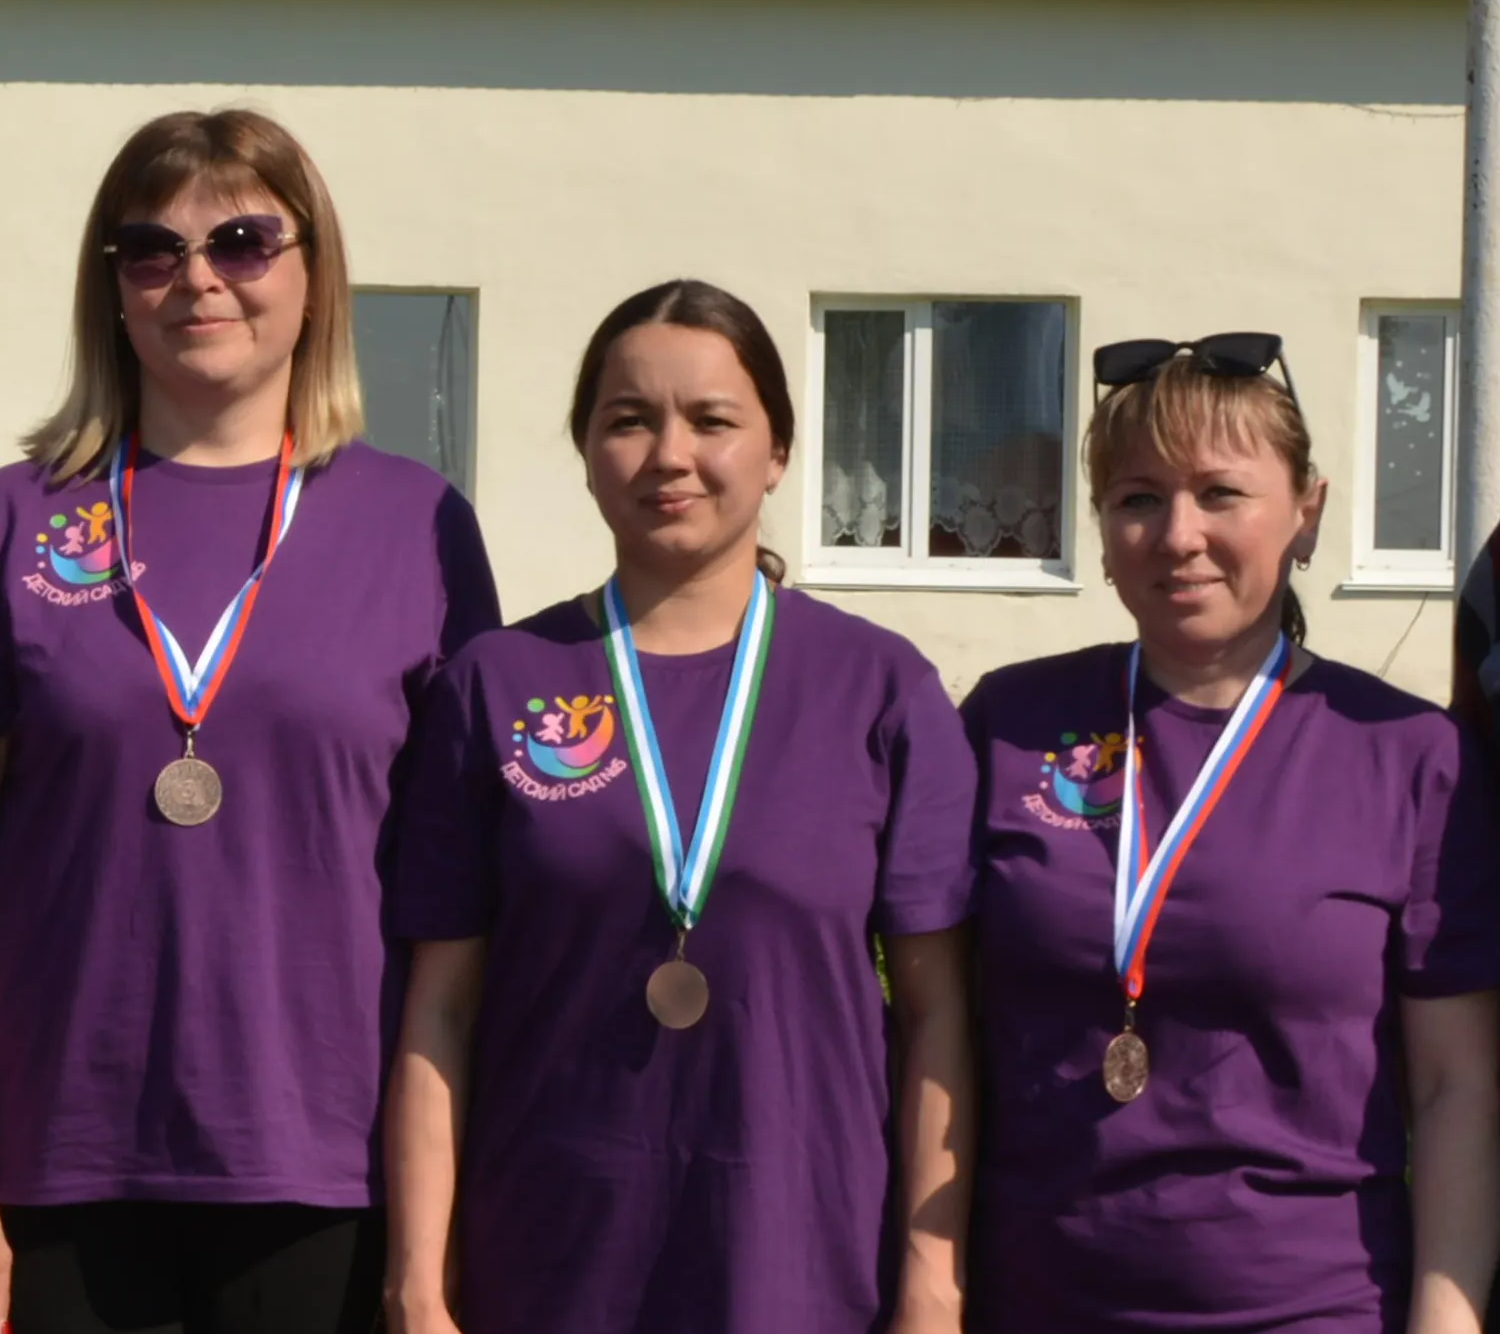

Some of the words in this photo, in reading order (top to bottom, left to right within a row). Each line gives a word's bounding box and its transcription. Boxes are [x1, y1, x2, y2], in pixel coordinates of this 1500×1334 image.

[21, 572, 89, 607] ДЕТСКИЙ
[500, 759, 567, 802] ДЕТСКИЙ
[567, 776, 606, 798] САД
